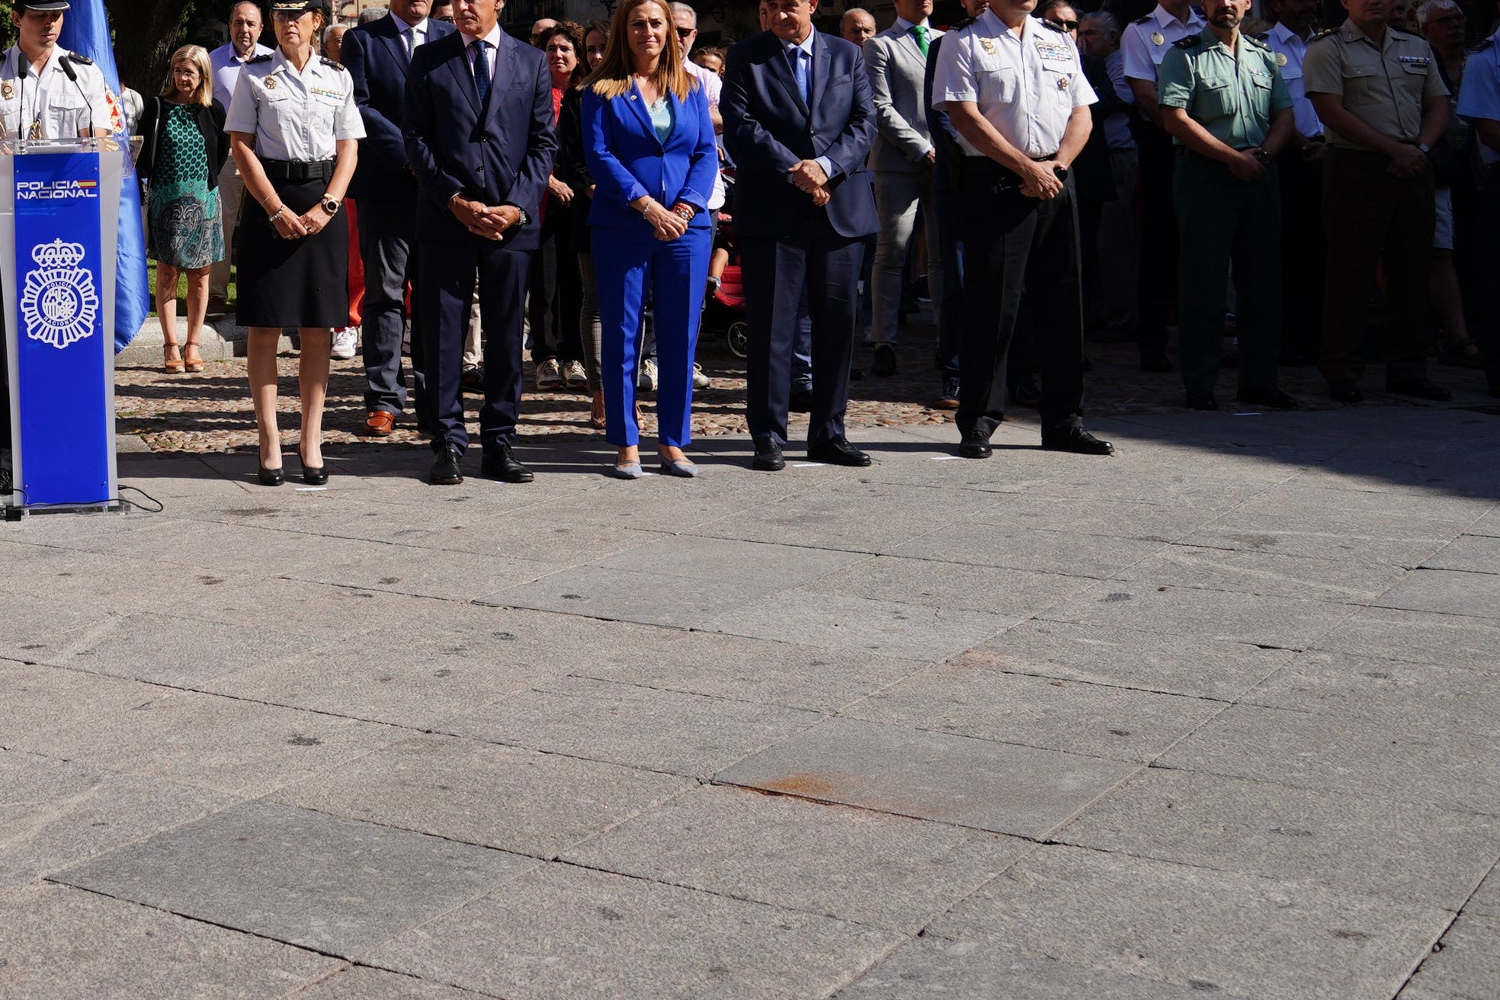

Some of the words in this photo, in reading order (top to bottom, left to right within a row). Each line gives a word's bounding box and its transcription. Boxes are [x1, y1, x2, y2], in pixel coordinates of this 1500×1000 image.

[17, 181, 81, 191] POLICIA
[17, 189, 97, 200] NACIONAL
[44, 316, 77, 327] NACIONAL
